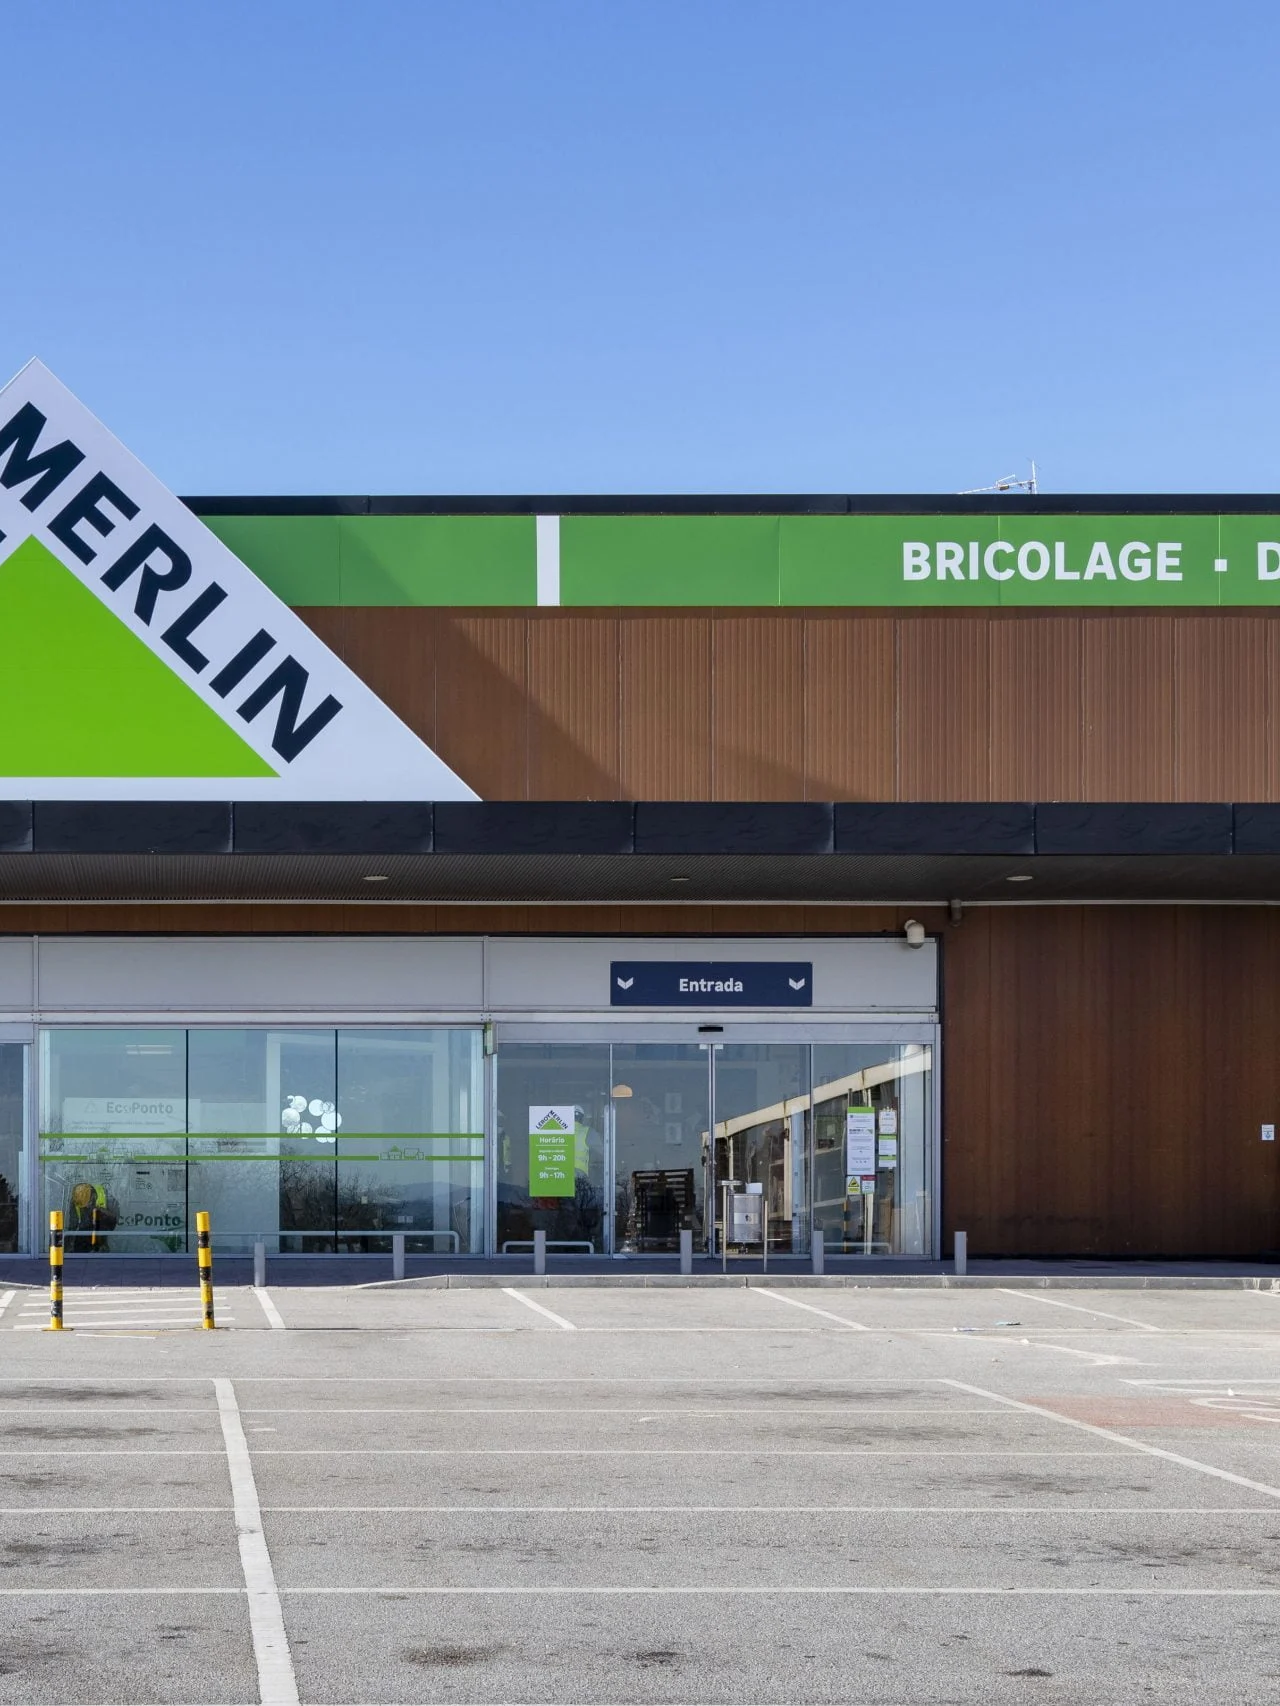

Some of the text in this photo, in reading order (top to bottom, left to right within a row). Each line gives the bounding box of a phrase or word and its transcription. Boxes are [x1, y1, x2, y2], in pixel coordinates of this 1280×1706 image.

[903, 541, 1183, 581] BRICOLAGE
[679, 978, 743, 992] Entrada
[536, 1110, 568, 1129] LEROY MERLIN
